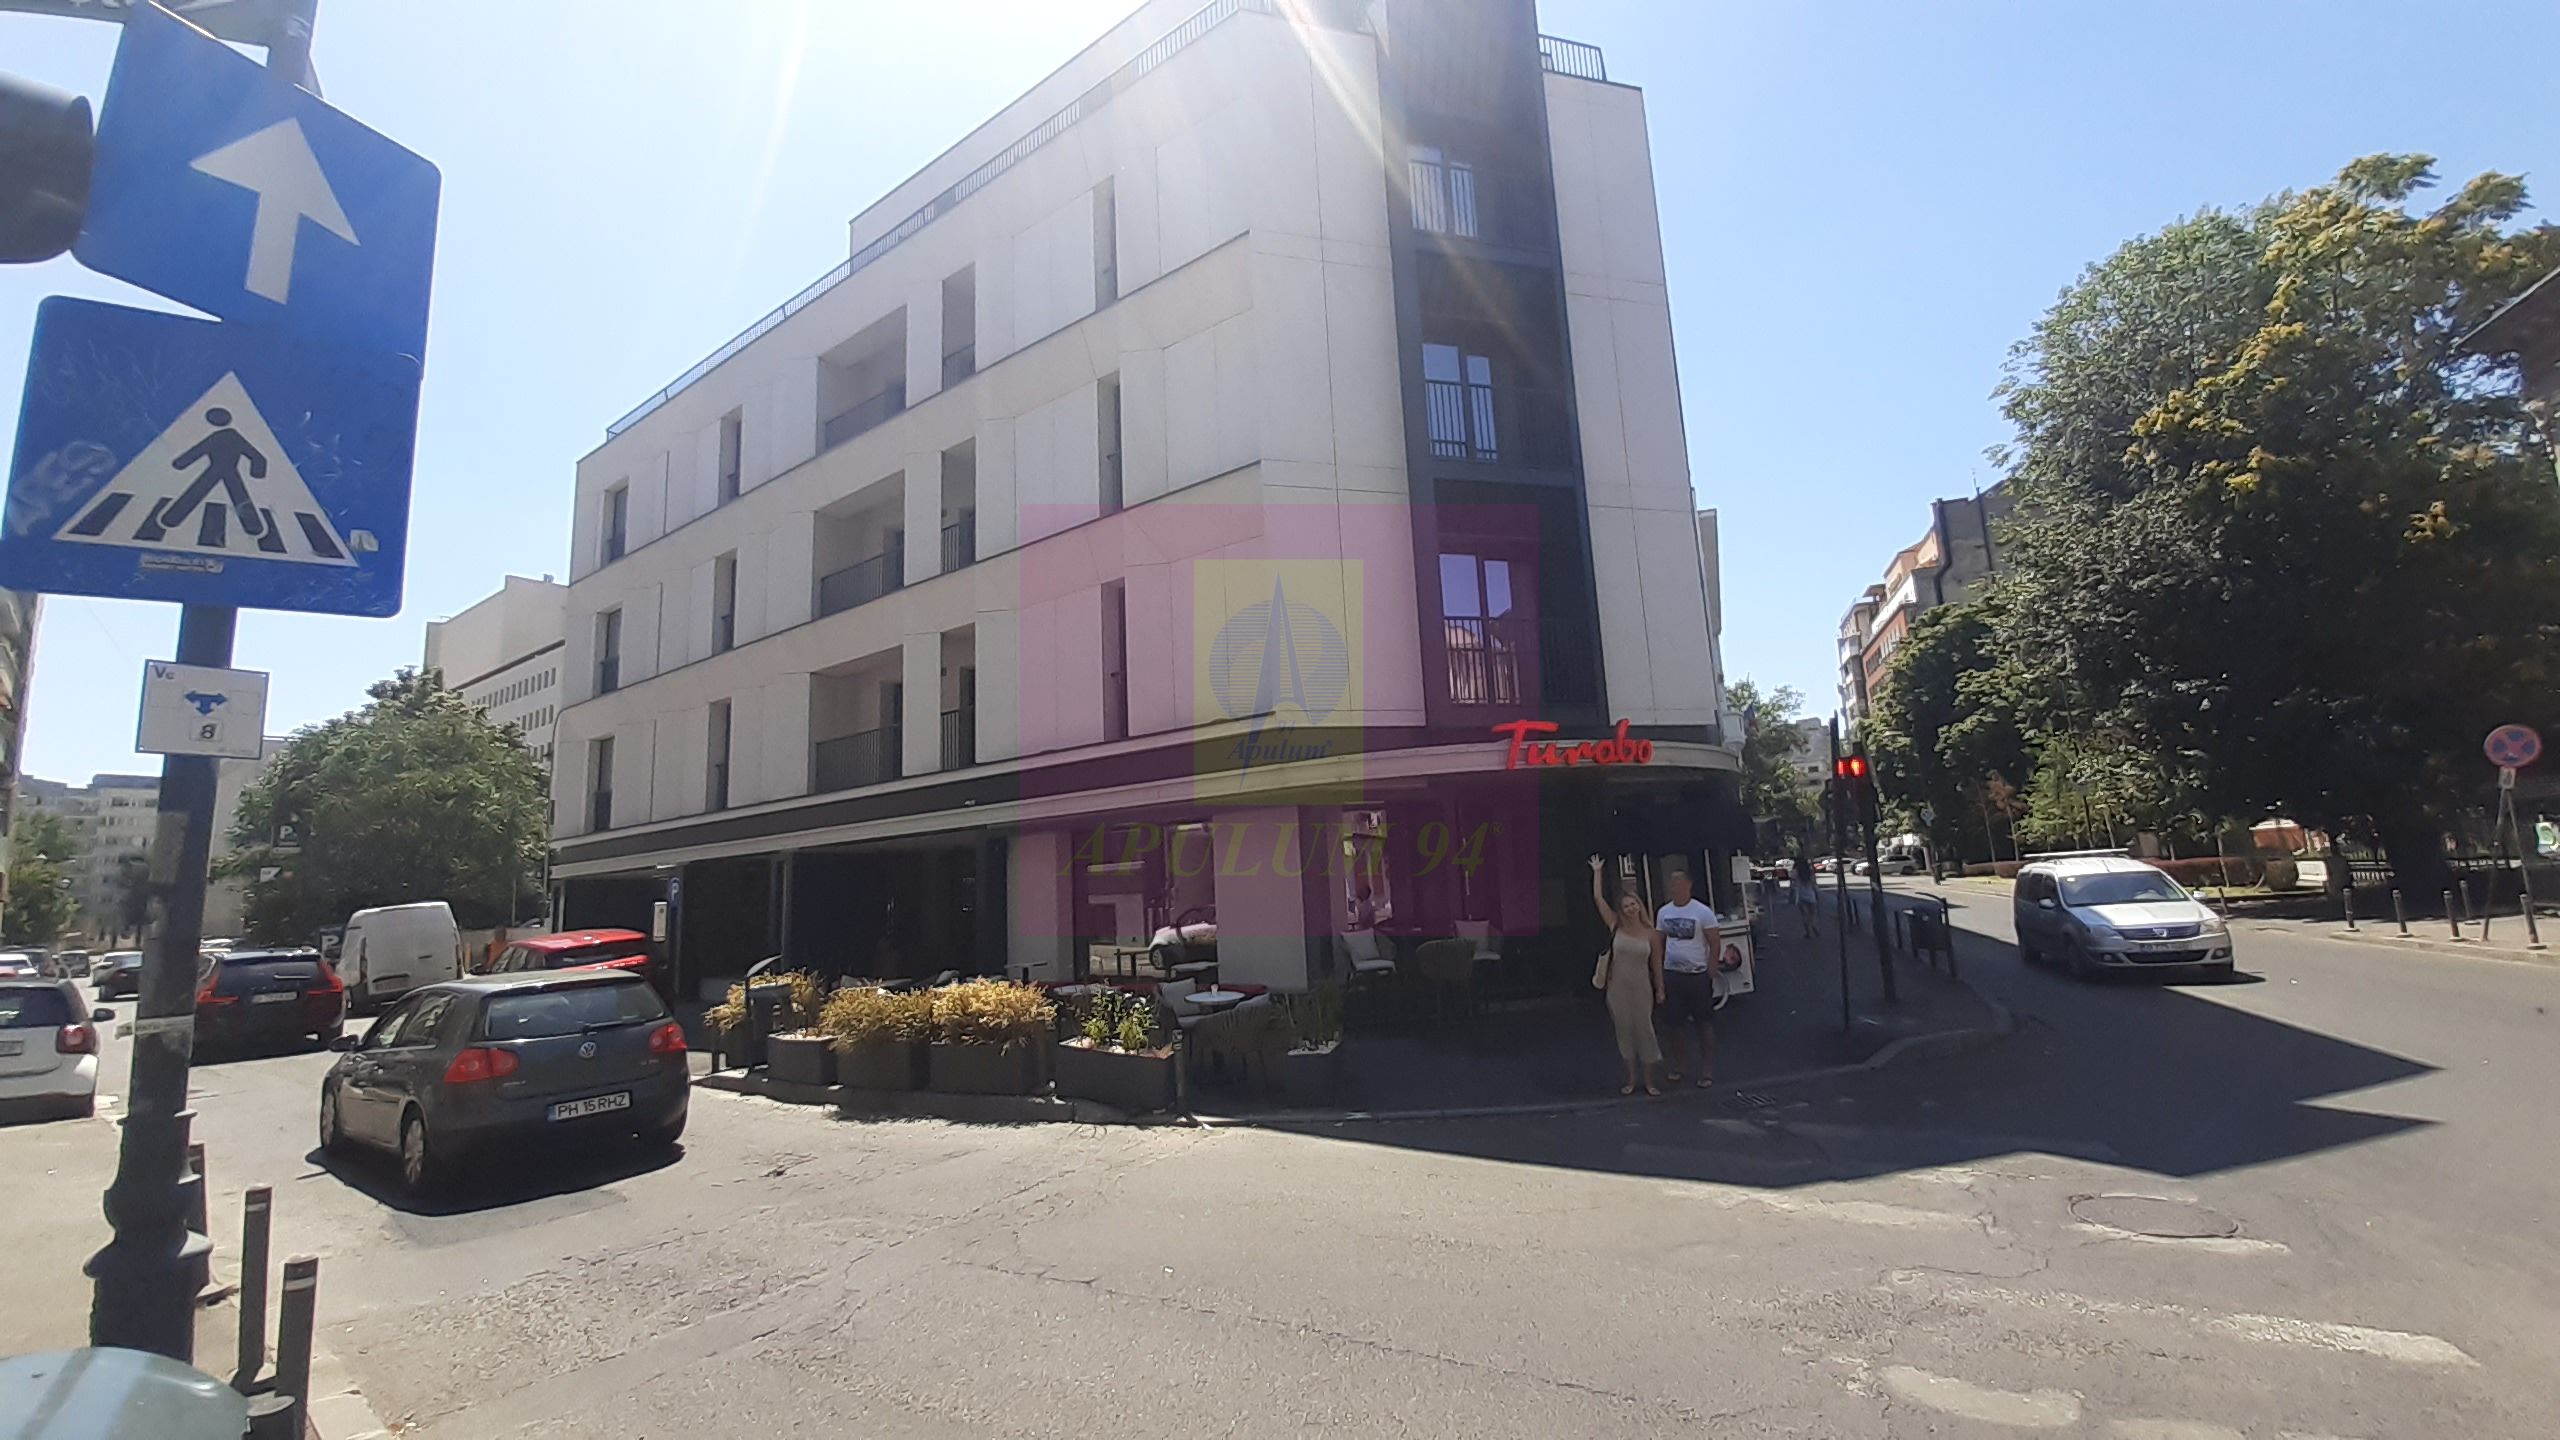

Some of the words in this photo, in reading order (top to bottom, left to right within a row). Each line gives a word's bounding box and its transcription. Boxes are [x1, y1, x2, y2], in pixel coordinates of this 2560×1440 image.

[201, 724, 217, 740] 8
[1491, 718, 1653, 769] Turabo
[557, 1104, 579, 1118] PH
[584, 1100, 596, 1112] 15
